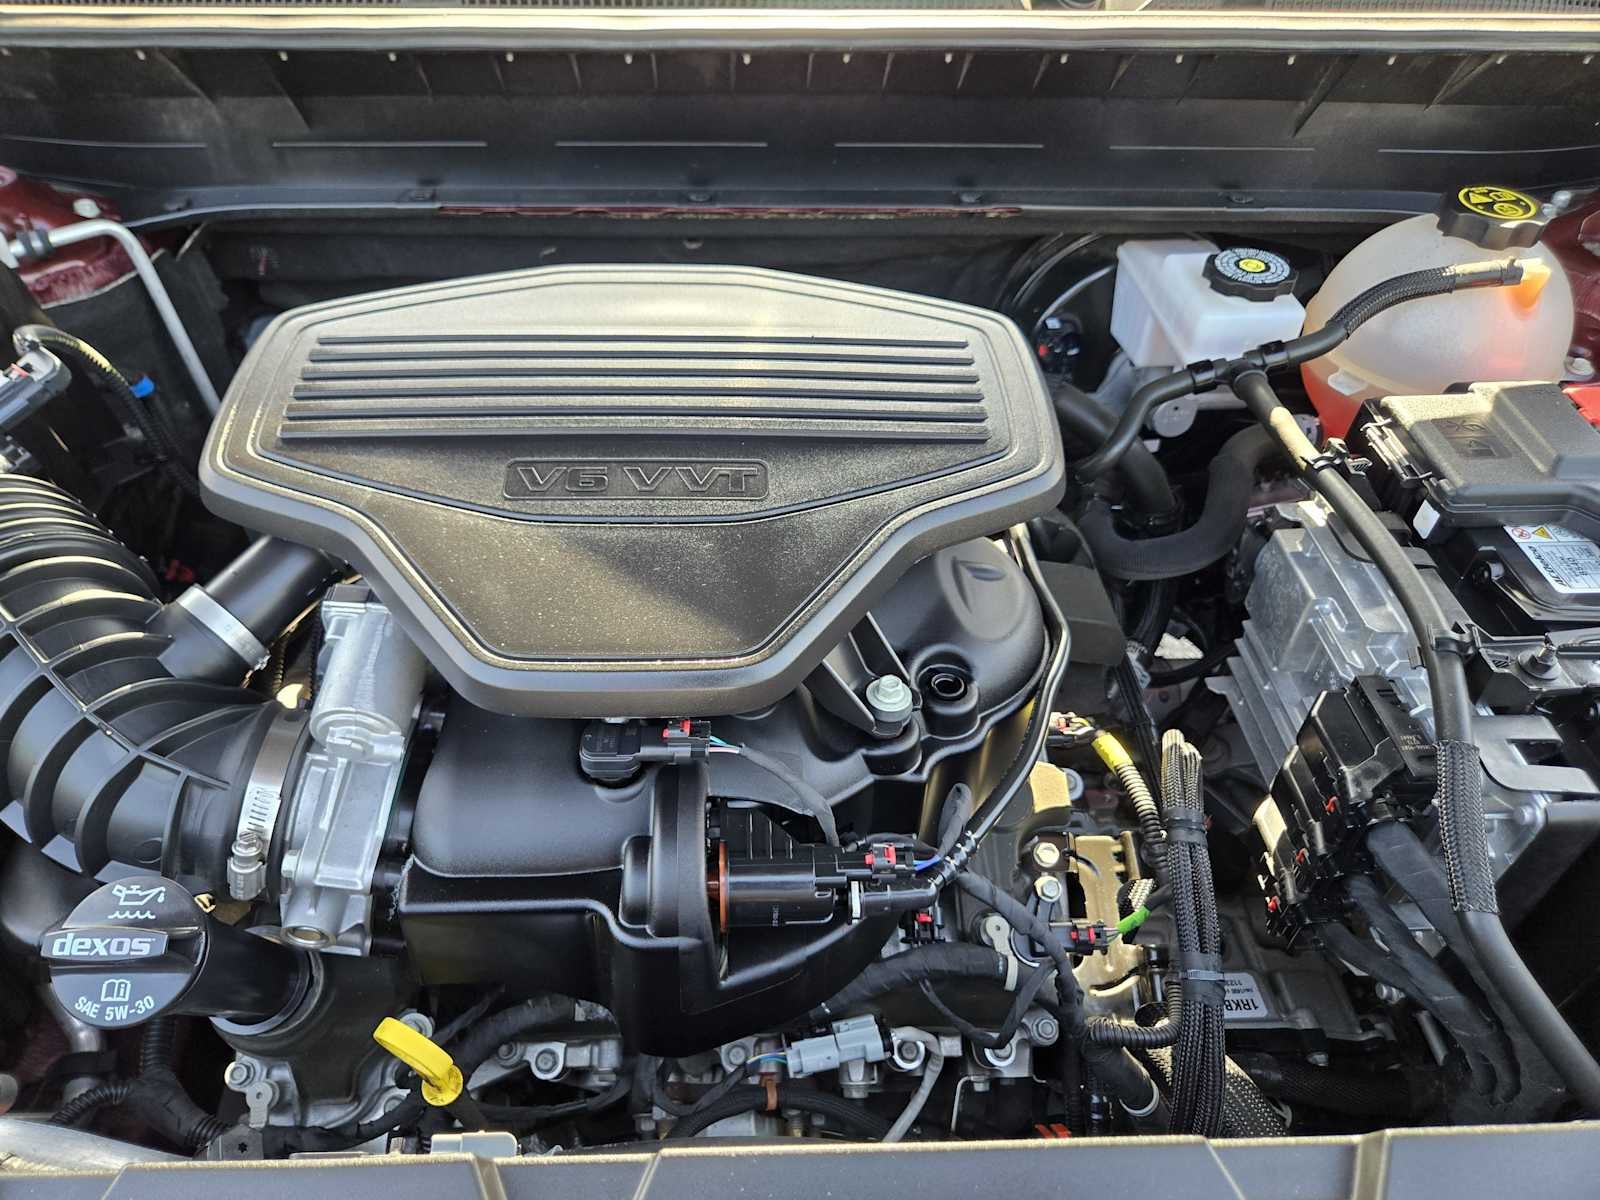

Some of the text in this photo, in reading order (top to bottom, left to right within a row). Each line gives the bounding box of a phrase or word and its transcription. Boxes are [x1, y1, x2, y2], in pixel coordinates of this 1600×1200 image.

[516, 466, 758, 492] V6 VVT
[52, 932, 152, 957] dexos
[74, 995, 155, 1021] SAE 5W-30
